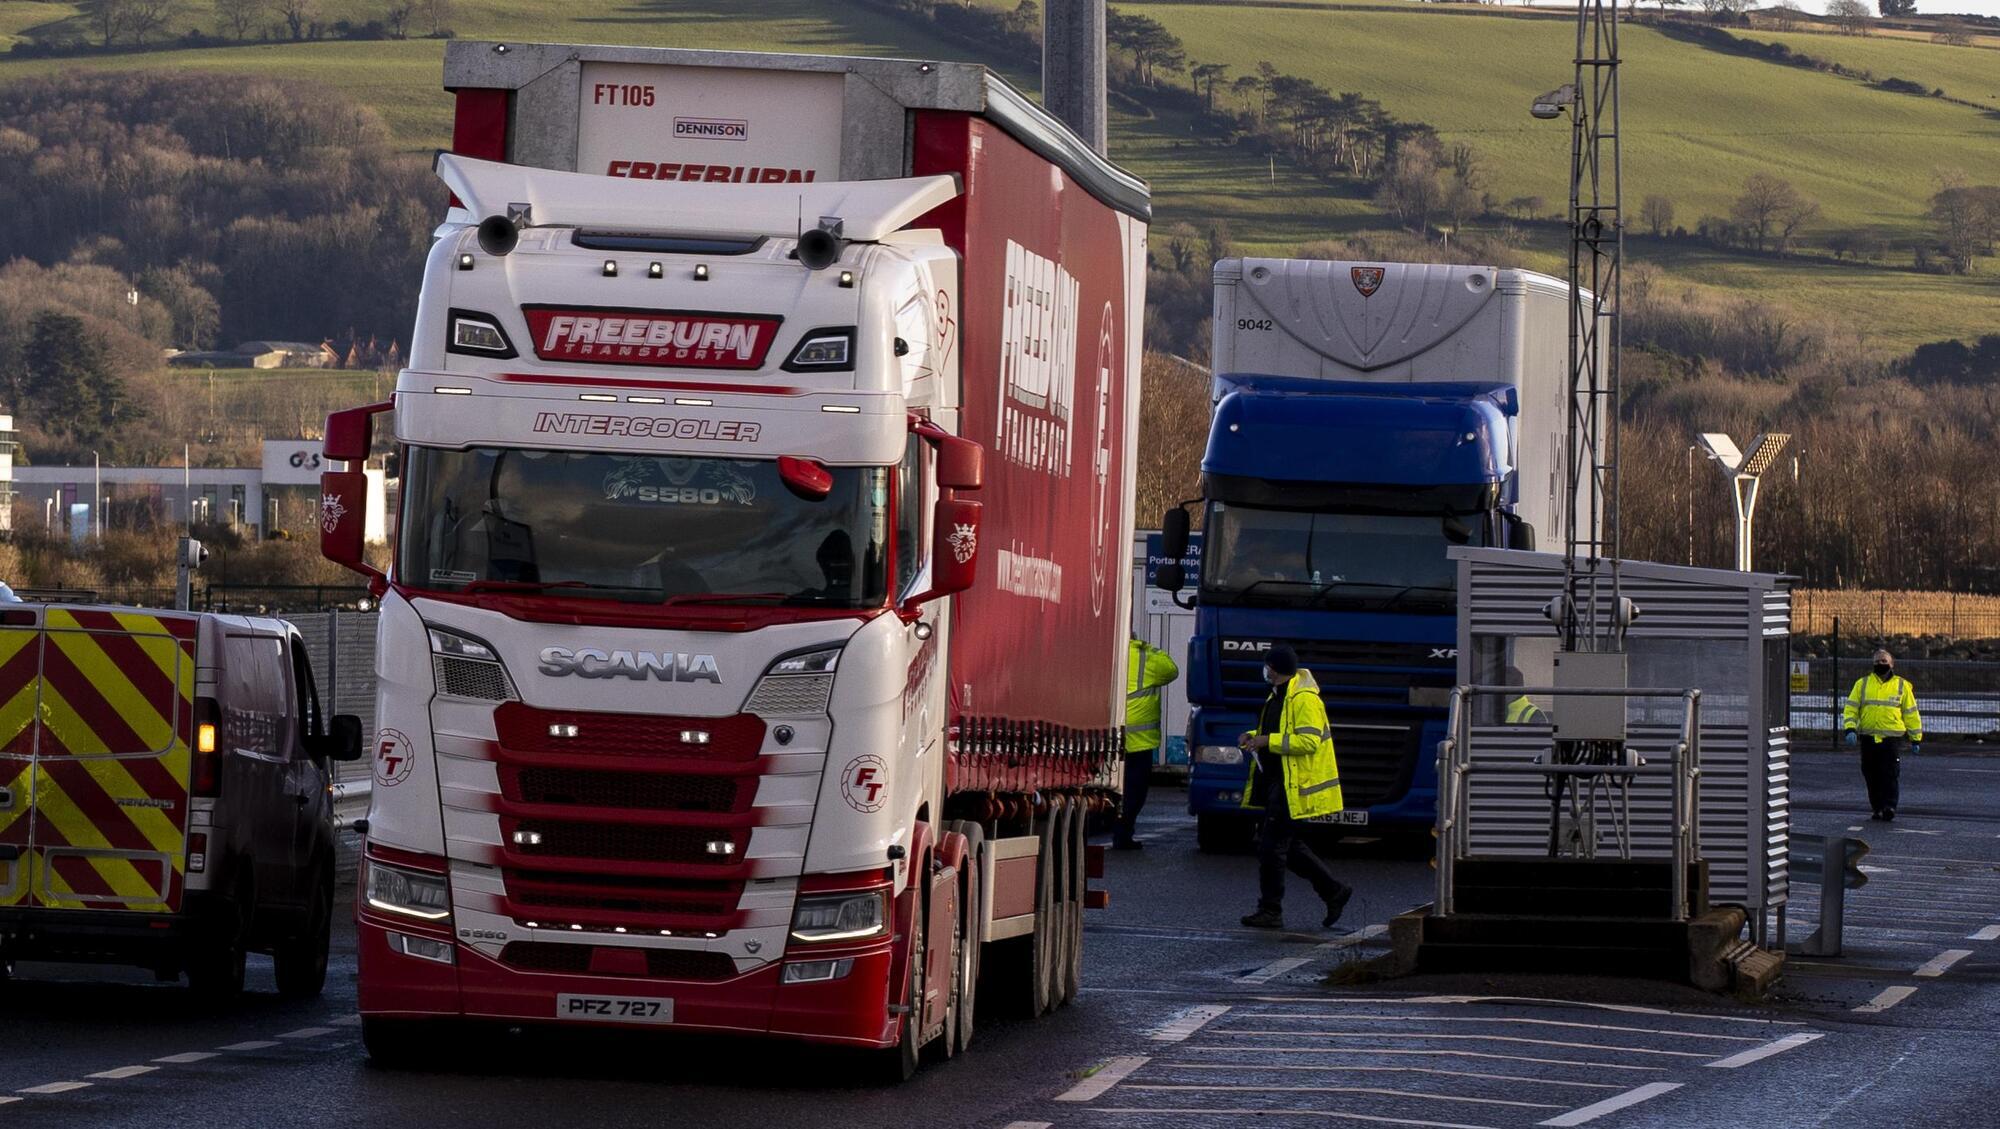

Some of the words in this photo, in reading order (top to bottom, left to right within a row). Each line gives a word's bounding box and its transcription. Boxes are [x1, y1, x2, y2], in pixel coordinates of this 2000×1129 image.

[594, 83, 655, 107] FT105
[675, 123, 745, 137] DENNISON
[1237, 318, 1273, 331] 9042
[543, 316, 760, 360] FREEBURN
[565, 343, 727, 360] TRANSPORT
[533, 412, 762, 442] INTERCOOLER
[638, 486, 720, 504] S580
[1223, 640, 1272, 651] DAF
[538, 646, 723, 684] SCANIA
[568, 998, 612, 1015] PFZ
[617, 1001, 661, 1016] 727
